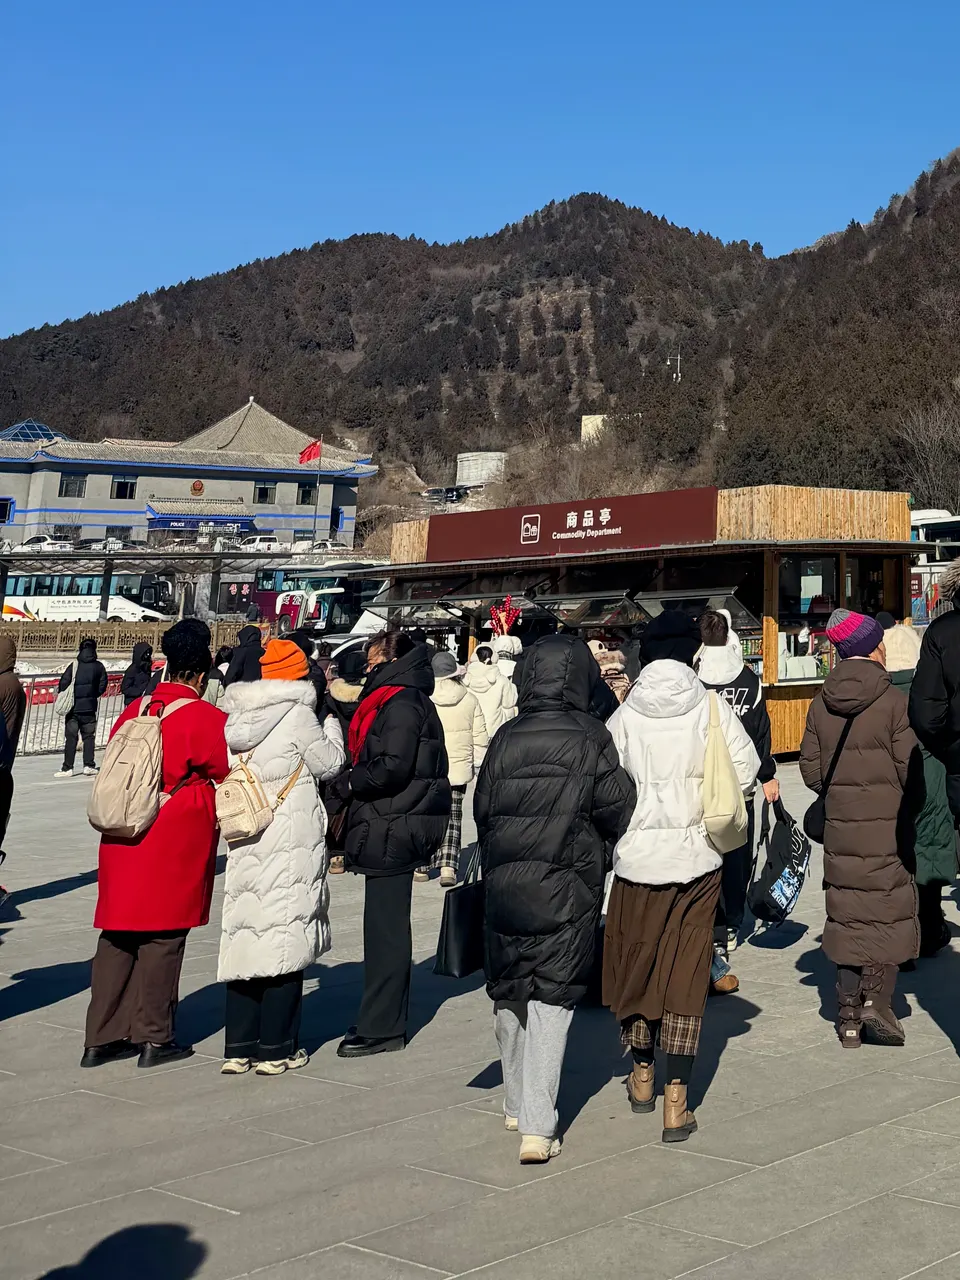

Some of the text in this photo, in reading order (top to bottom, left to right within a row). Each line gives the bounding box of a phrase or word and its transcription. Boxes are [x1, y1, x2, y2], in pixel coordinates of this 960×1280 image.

[566, 508, 611, 529] 商品亭
[586, 526, 622, 538] Department
